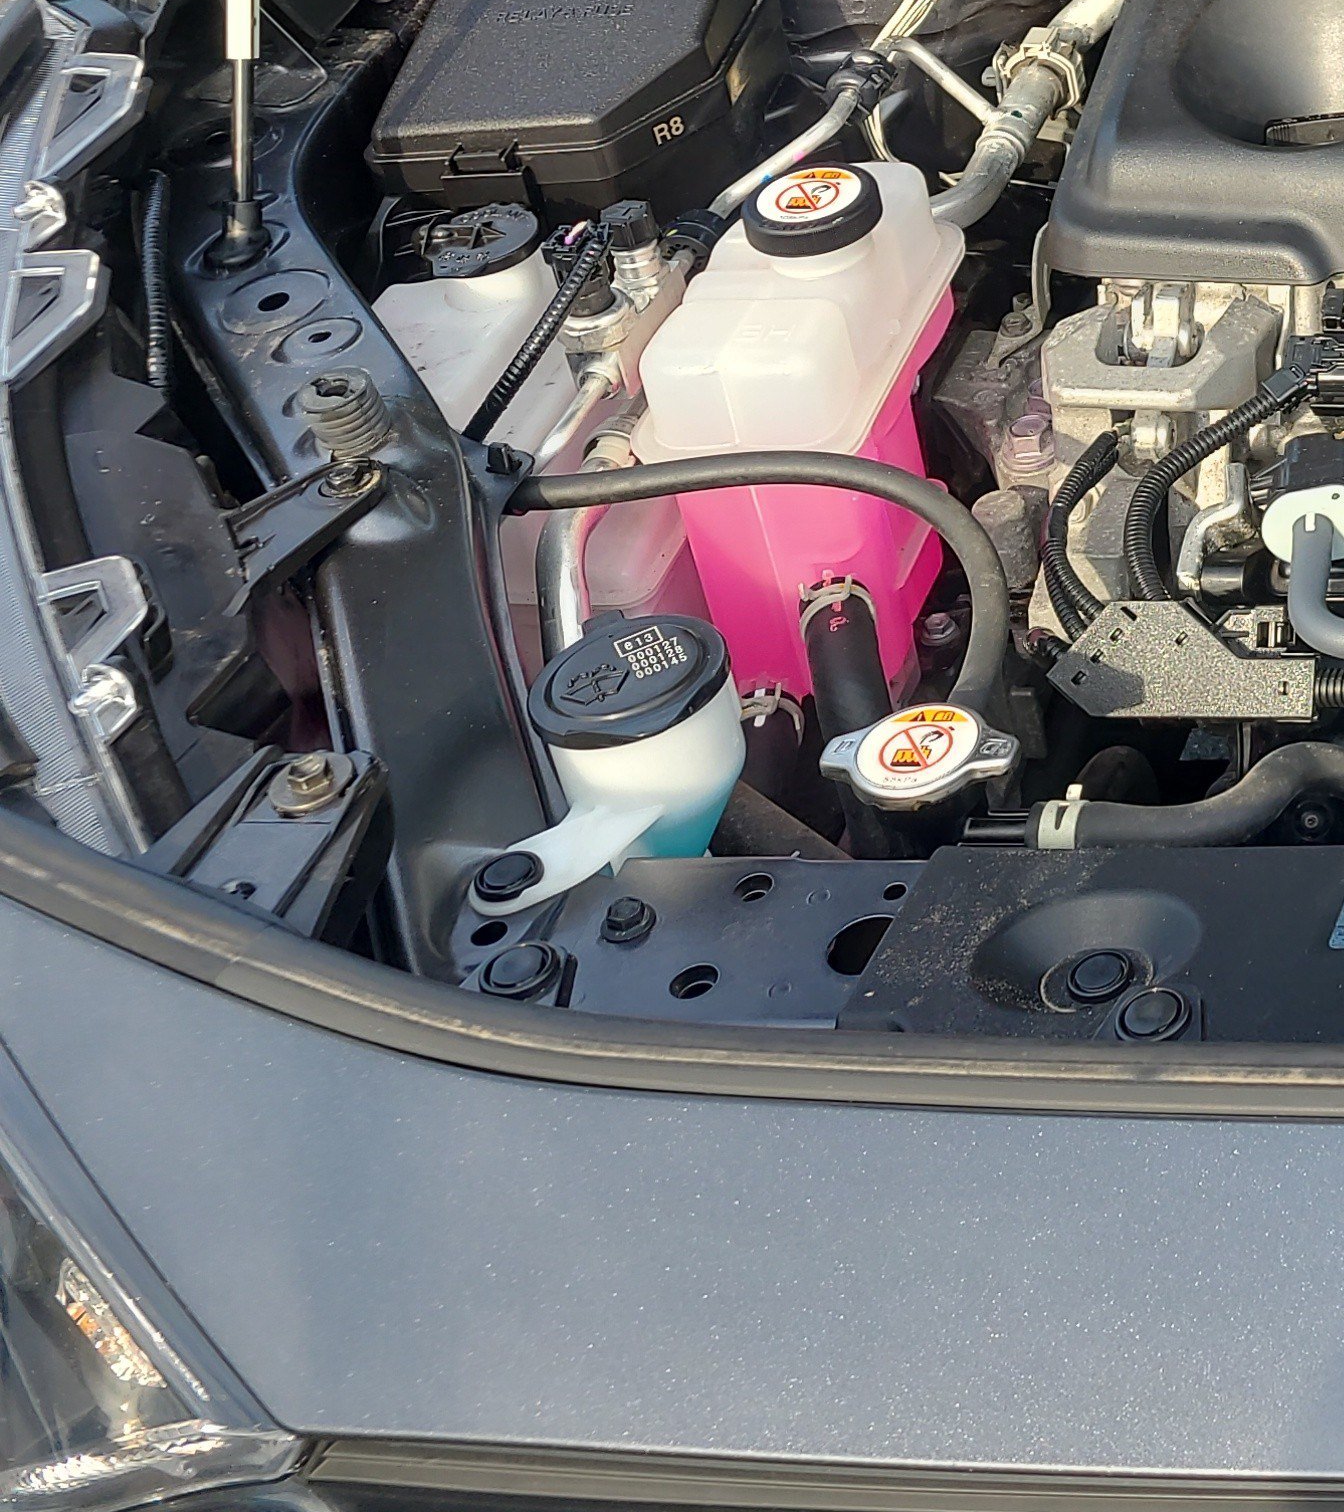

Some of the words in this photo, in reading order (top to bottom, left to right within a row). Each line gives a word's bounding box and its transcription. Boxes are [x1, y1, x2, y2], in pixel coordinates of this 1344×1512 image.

[652, 116, 685, 145] R8
[623, 633, 654, 651] e13
[627, 636, 679, 663] 000127
[631, 645, 684, 671] 000128
[635, 654, 688, 679] 000145
